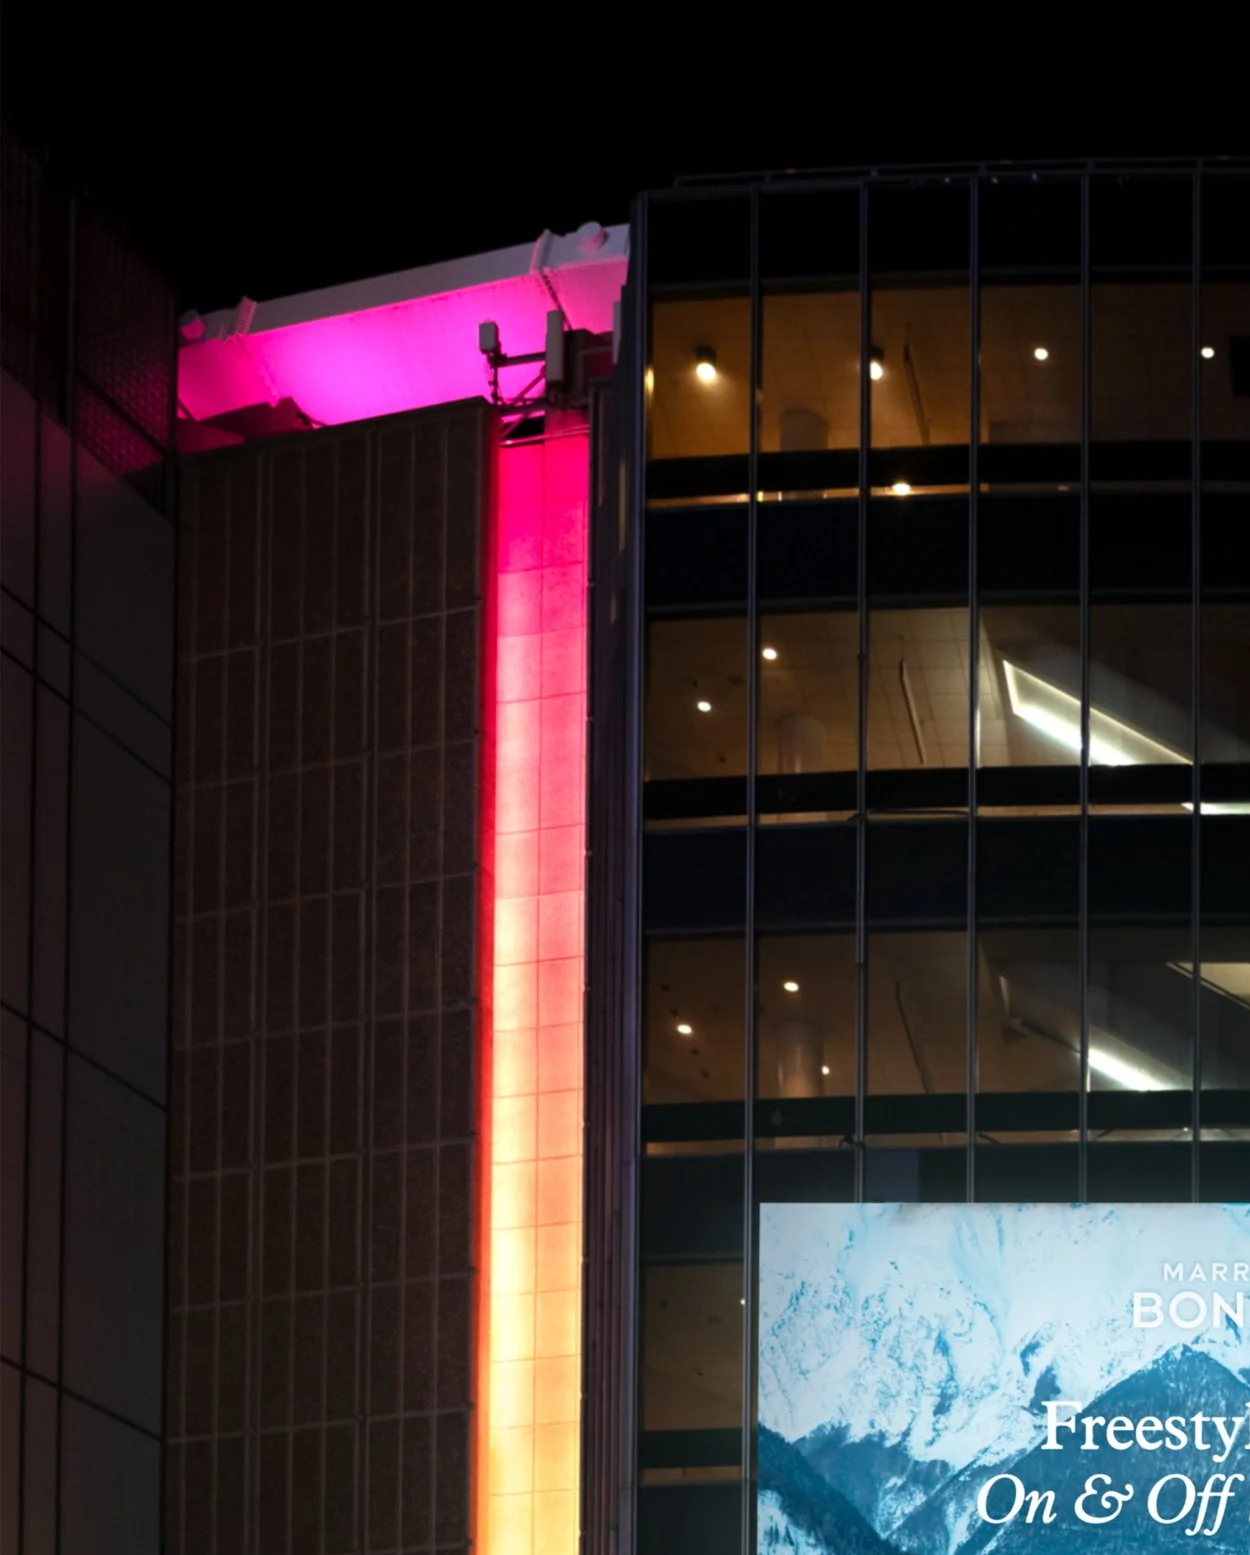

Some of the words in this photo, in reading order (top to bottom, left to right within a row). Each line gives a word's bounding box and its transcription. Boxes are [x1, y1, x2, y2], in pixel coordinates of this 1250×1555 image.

[976, 1473, 1057, 1524] On
[1074, 1473, 1134, 1524] &
[1147, 1473, 1245, 1536] Off
